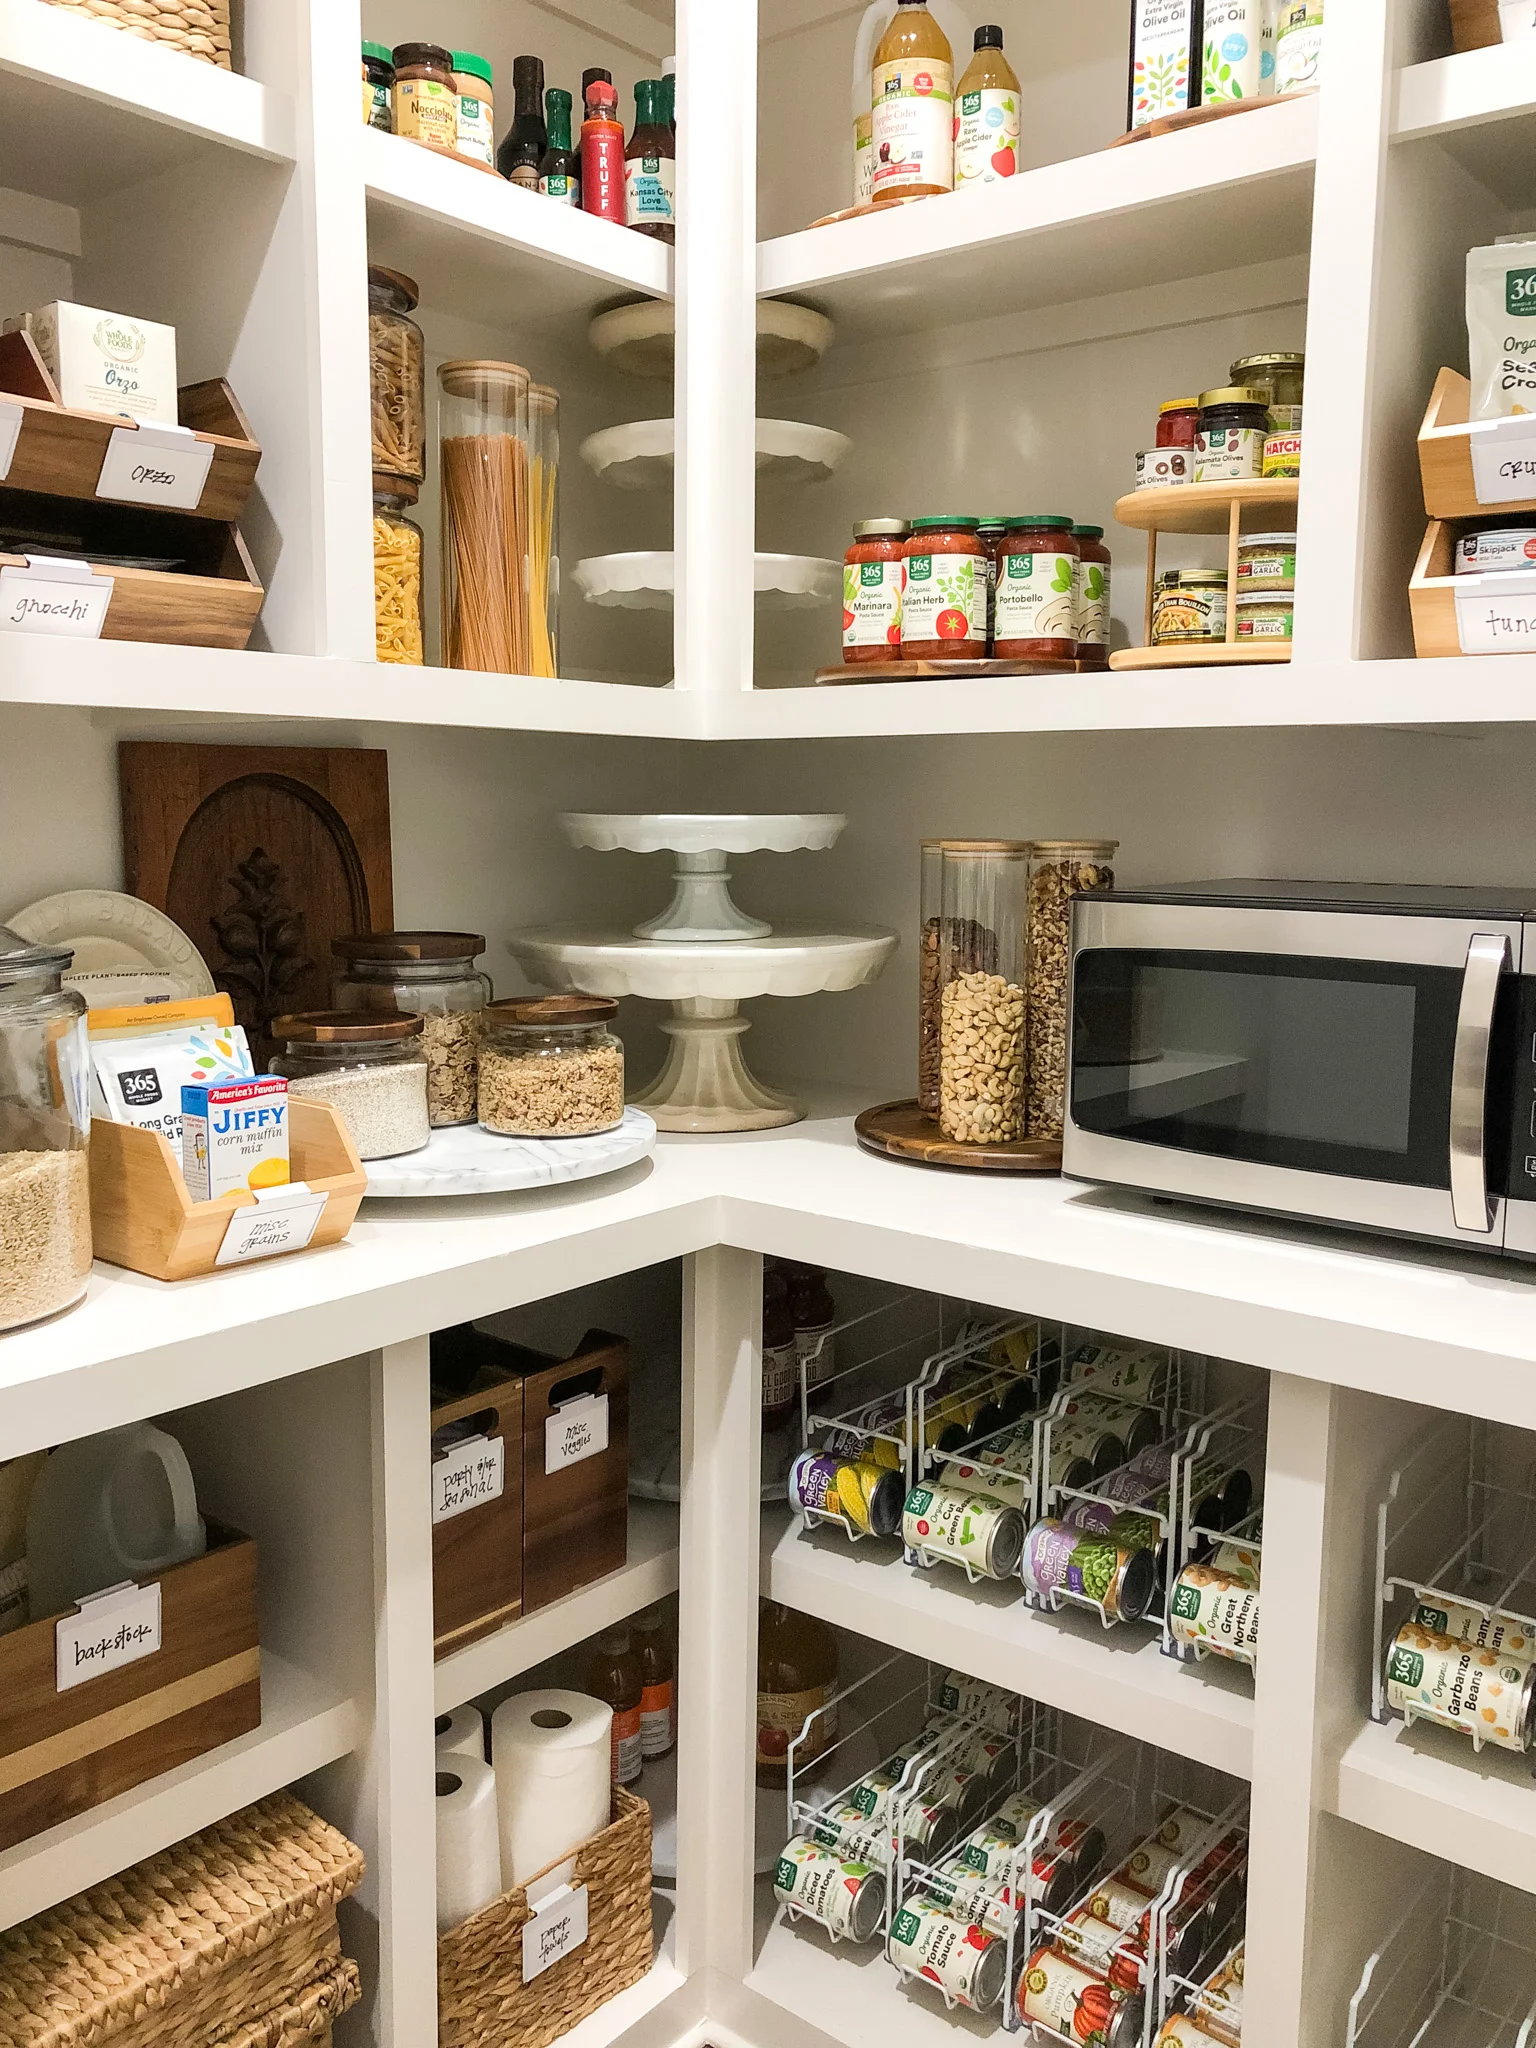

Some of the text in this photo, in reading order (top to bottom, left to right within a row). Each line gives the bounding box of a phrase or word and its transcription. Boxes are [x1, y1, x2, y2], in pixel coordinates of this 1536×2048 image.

[1145, 8, 1162, 16] Extra
[1163, 2, 1183, 14] Virgin
[1227, 9, 1245, 21] Oil
[1143, 9, 1185, 28] Olive Oil
[887, 80, 900, 90] 365
[463, 102, 478, 112] 365
[965, 96, 980, 108] 365
[411, 100, 455, 122] Nocciolata
[963, 126, 978, 136] Raw
[972, 133, 993, 143] Cider
[643, 159, 658, 169] 365
[549, 178, 566, 190] 365
[598, 142, 610, 211] TRUFF
[630, 187, 674, 200] Kansas City
[642, 197, 661, 205] Love
[106, 329, 133, 343] WHOLE
[108, 338, 133, 350] FOODS
[104, 360, 140, 374] ORGANIC
[105, 369, 140, 395] Orzo
[1211, 433, 1225, 443] 365
[1266, 440, 1302, 455] HATCH
[1222, 454, 1244, 462] Olives
[1147, 476, 1168, 484] Olives
[1479, 544, 1517, 555] Skipjack
[862, 565, 882, 579] 365
[911, 559, 930, 573] 365
[1009, 557, 1030, 571] 365
[1253, 567, 1281, 575] GARLIC
[860, 591, 883, 602] Organic
[908, 585, 932, 597] Organic
[1007, 583, 1032, 593] Organic
[853, 602, 893, 612] Marinara
[902, 595, 945, 607] talian Herb
[999, 594, 1044, 605] Portobello
[1178, 598, 1211, 615] BOUILLON
[10, 598, 90, 624] gnocchi
[91, 971, 139, 980] PLANT-BASED
[124, 1074, 157, 1095] 365
[211, 1083, 287, 1102] America's Favorite
[213, 1106, 287, 1134] JIFFY
[217, 1126, 283, 1147] corn muffin
[240, 1141, 264, 1156] mix
[249, 1219, 290, 1236] misc
[910, 1490, 927, 1513] 365
[929, 1496, 949, 1524] Organic
[942, 1503, 957, 1521] Cut
[946, 1514, 961, 1546] Green
[1176, 1587, 1194, 1617] 365
[1206, 1595, 1223, 1630] Organic
[1220, 1598, 1238, 1635] Great
[1232, 1593, 1255, 1649] Northern
[73, 1623, 153, 1667] backstock
[1395, 1651, 1415, 1684] 365
[1431, 1661, 1449, 1699] Organic
[1446, 1653, 1472, 1717] Garbanzo
[1463, 1669, 1484, 1712] Beans
[848, 1835, 864, 1861] Dice
[777, 1863, 791, 1889] 365
[797, 1869, 812, 1900] Organic
[807, 1871, 822, 1906] Diced
[966, 1885, 987, 1921] omao
[975, 1898, 992, 1927] Sauc
[897, 1913, 914, 1942] 365
[918, 1924, 937, 1956] Organic
[926, 1923, 950, 1967] Tomato
[937, 1933, 958, 1969] Sauce
[1050, 1974, 1074, 2020] Pumpkin
